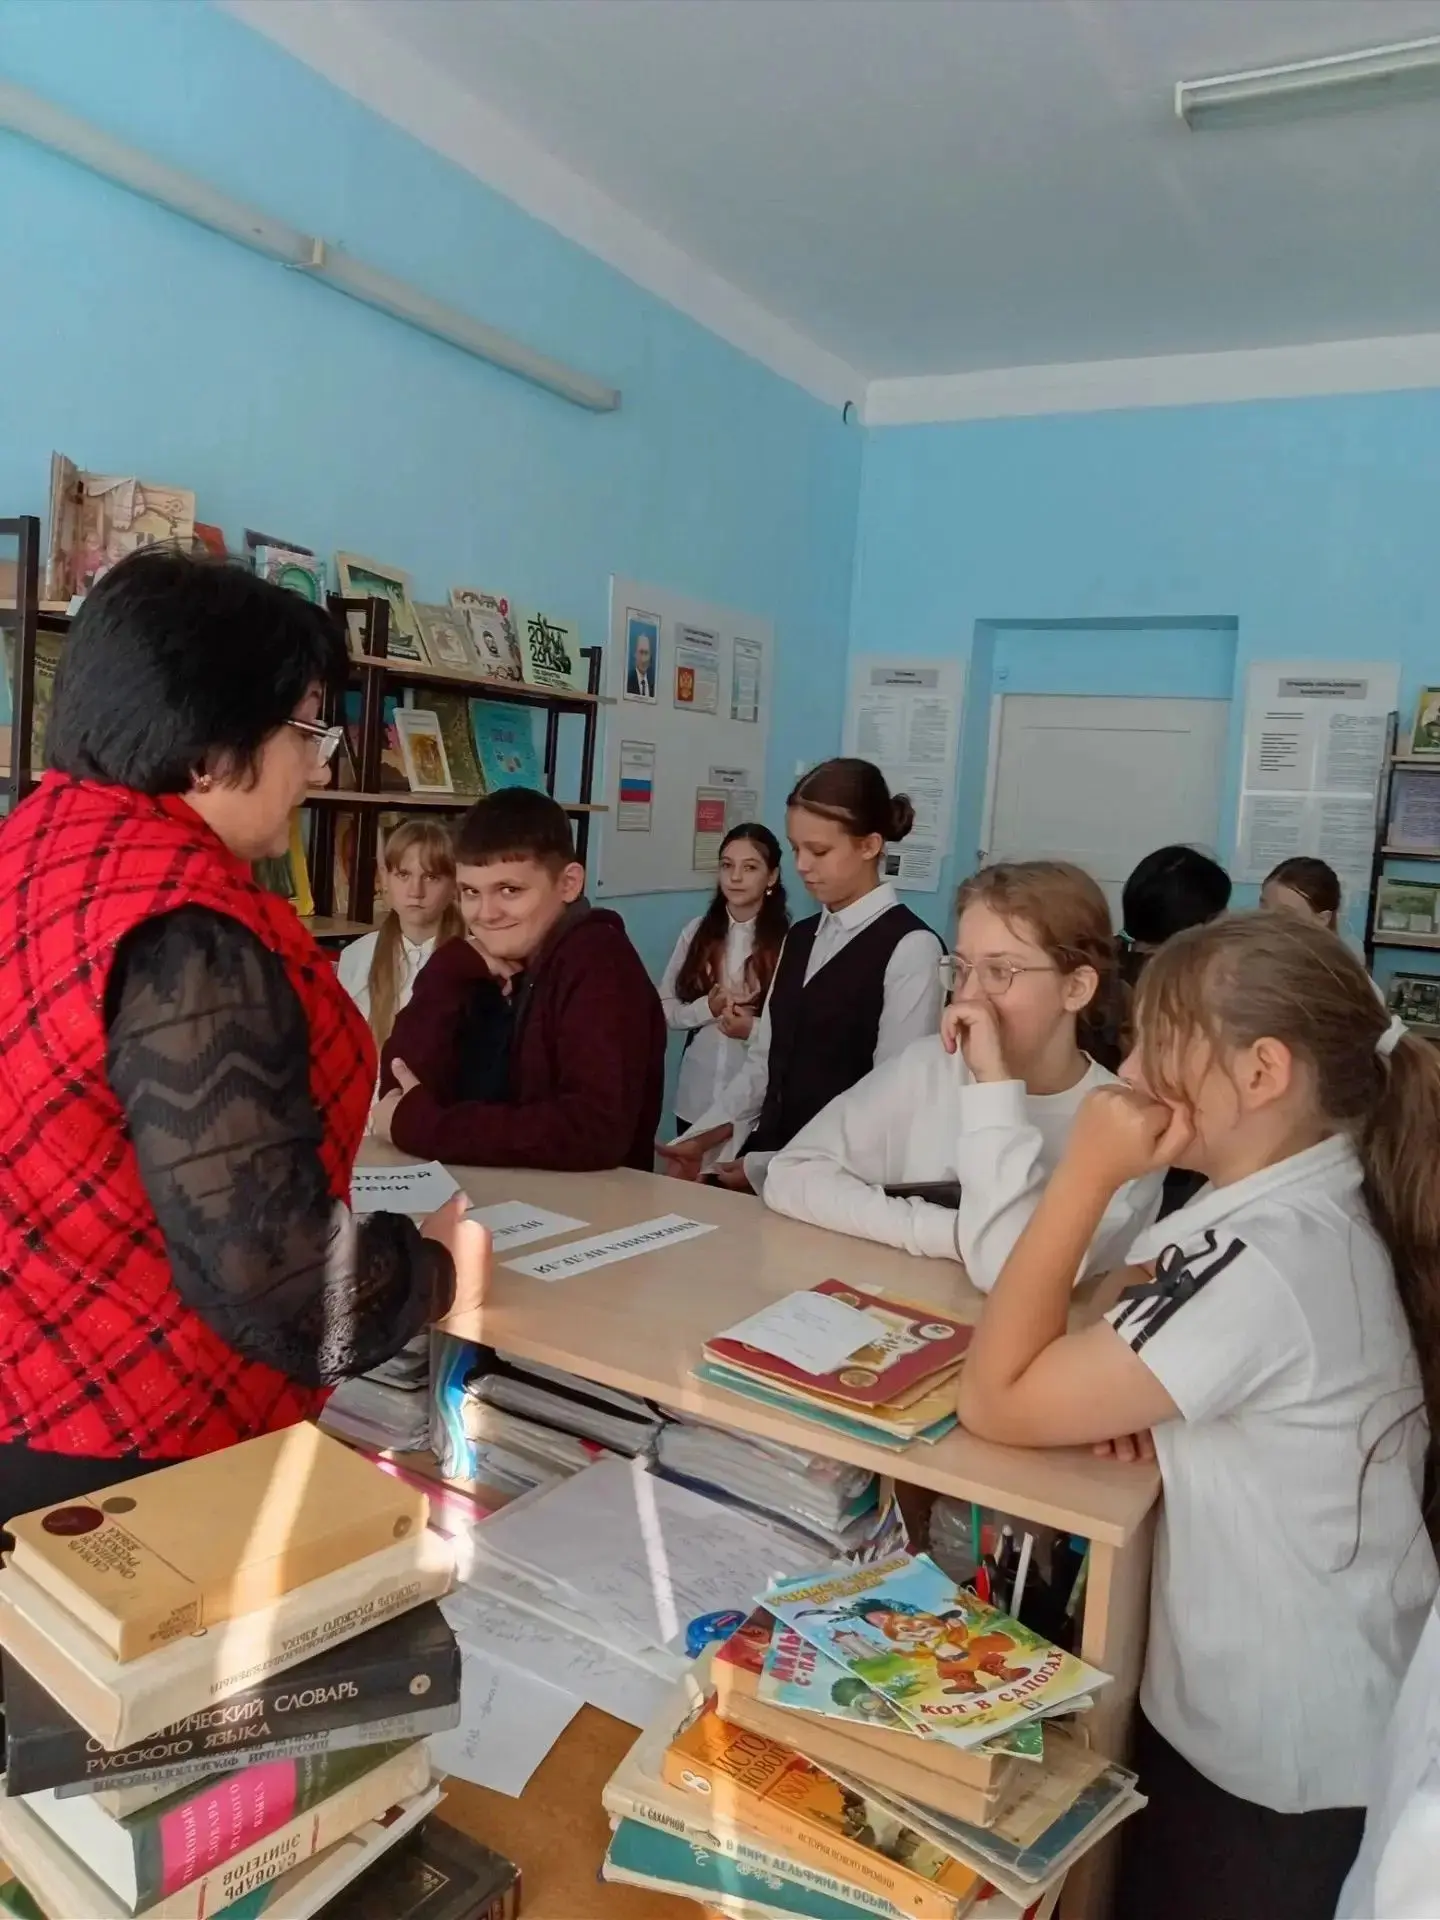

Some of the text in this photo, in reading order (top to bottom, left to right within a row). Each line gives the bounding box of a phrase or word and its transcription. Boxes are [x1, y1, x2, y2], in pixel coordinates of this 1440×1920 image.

[351, 1184, 410, 1192] теки
[352, 1170, 432, 1181] ателей
[533, 1221, 699, 1275] КНИЖКИНА НЕДЕЛЯ
[274, 1682, 359, 1713] СЛОВАРЬ
[920, 1650, 1064, 1716] КОТ В САПОГАХ
[86, 1739, 193, 1773] РУССКОГО
[204, 1721, 272, 1749] ЯЗЫКА
[712, 1732, 777, 1778] ИСТО
[207, 1800, 220, 1861] СЛОВАРЬ
[229, 1783, 243, 1850] РУССКОГО
[254, 1781, 266, 1828] ЯЗЫКА
[223, 1834, 301, 1886] ЭПИТЕТОВ
[225, 1852, 297, 1900] СЛОВАРЬ
[737, 1842, 769, 1866] МИРЕ
[772, 1856, 839, 1892] ДЕЛЬФИНА
[841, 1882, 851, 1897] И
